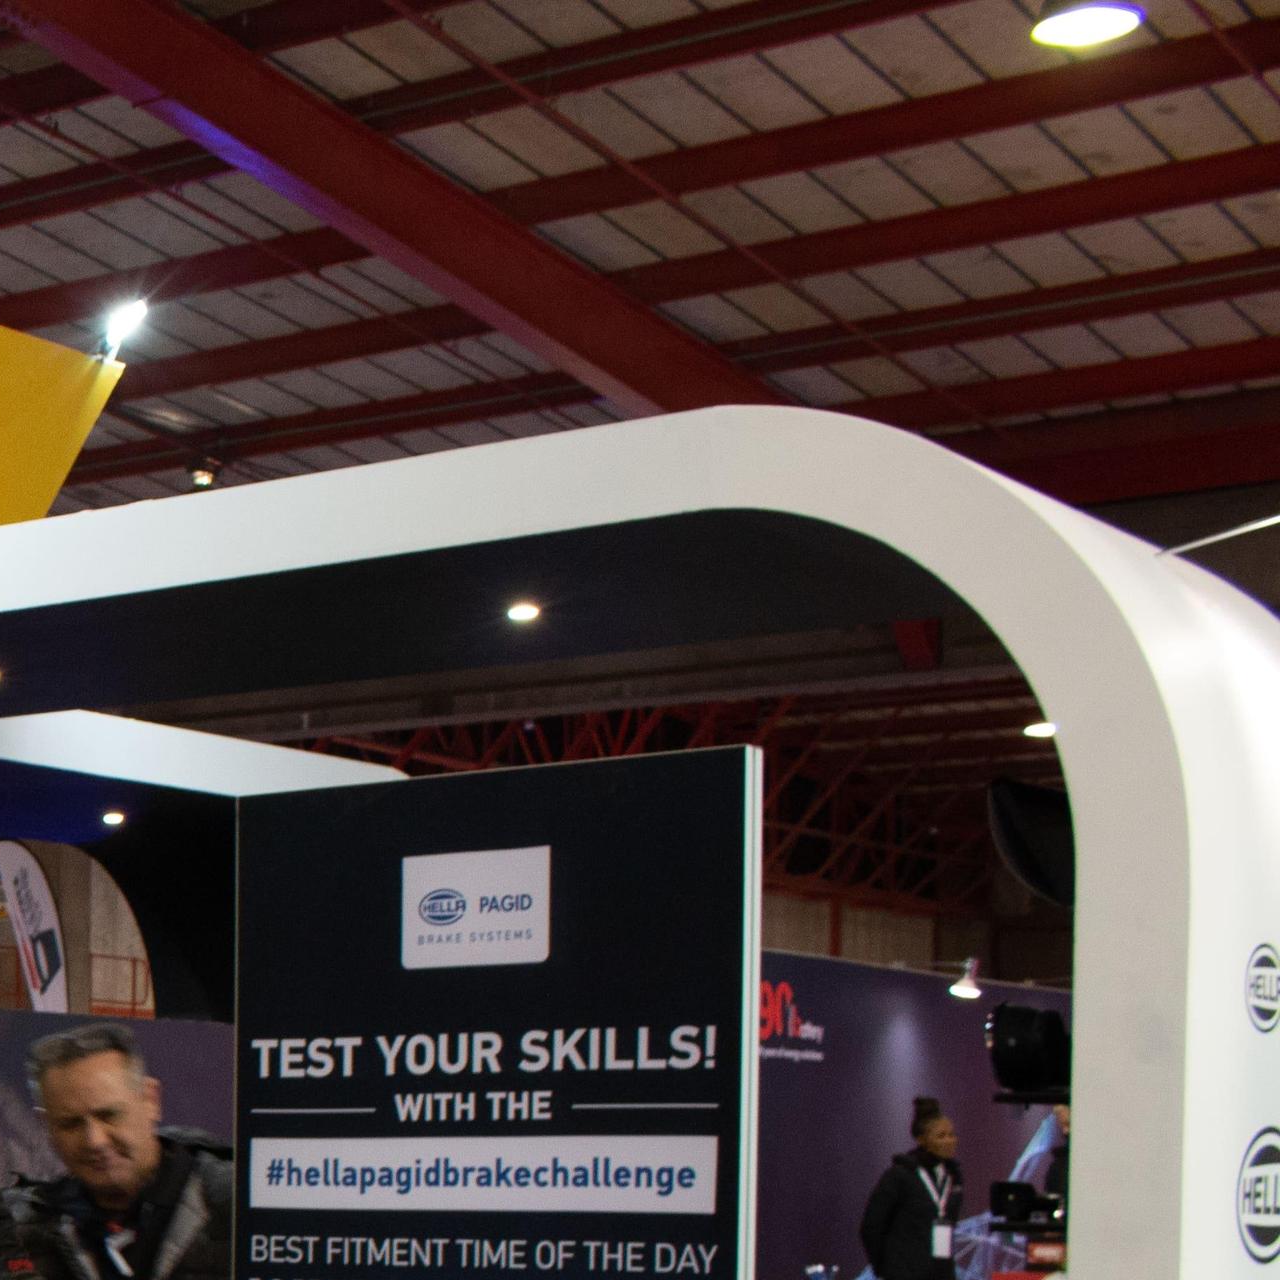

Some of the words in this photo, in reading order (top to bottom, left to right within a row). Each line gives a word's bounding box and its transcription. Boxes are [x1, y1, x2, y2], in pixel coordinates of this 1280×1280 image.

[422, 899, 466, 913] HELLA
[479, 893, 533, 913] PAGID
[417, 933, 463, 946] BRAKE
[469, 928, 533, 943] SYSTEMS
[251, 1036, 362, 1079] TEST
[376, 1031, 502, 1077] YOUR
[518, 1025, 718, 1073] SKILLS!
[394, 1092, 476, 1122] WITH
[486, 1090, 552, 1121] THE
[266, 1157, 696, 1196] #hellapagidbrakechallenge
[250, 1235, 319, 1264] BEST
[326, 1236, 449, 1268] FITMENT
[456, 1239, 527, 1270] TIME
[535, 1240, 575, 1271] OF
[583, 1241, 644, 1273] THE
[653, 1243, 718, 1275] DAY
